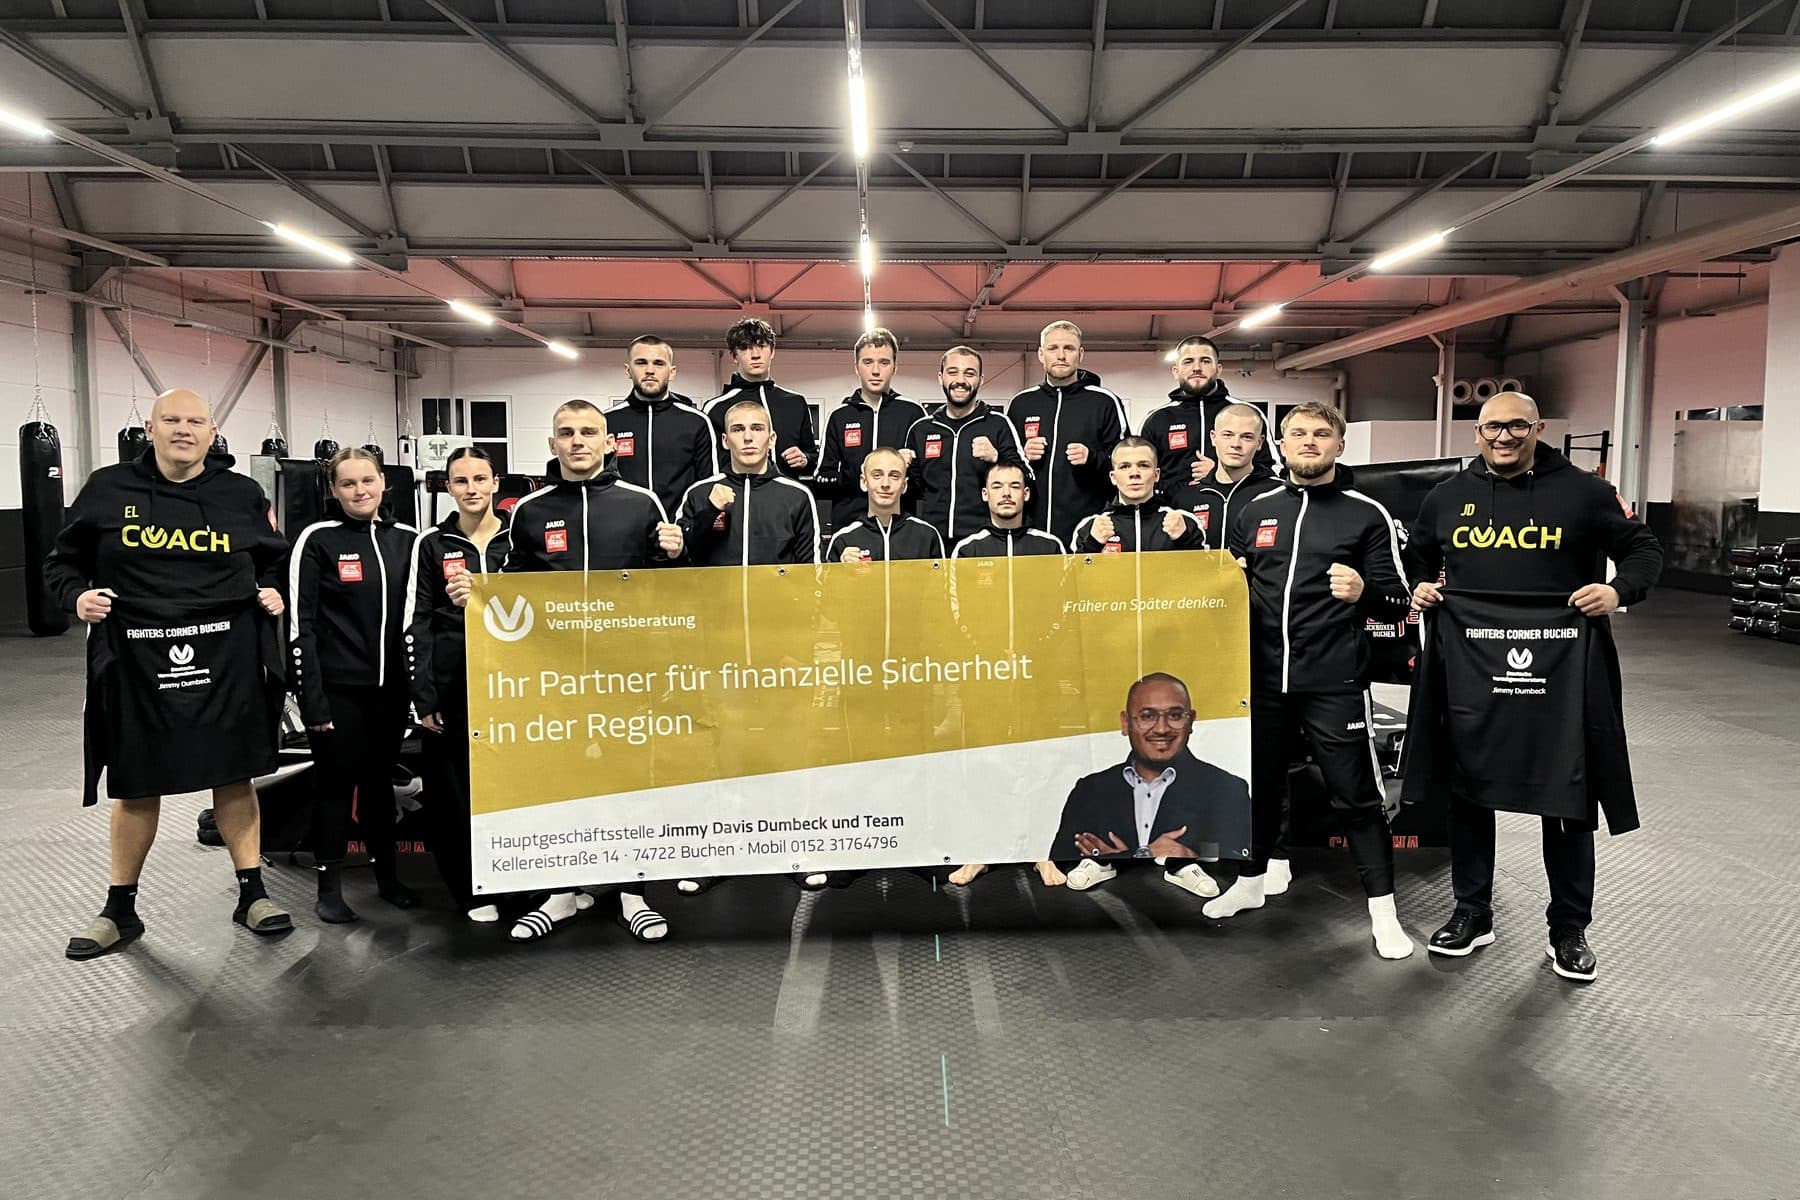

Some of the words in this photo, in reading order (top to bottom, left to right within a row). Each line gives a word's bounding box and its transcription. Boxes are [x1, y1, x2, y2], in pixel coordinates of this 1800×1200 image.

[124, 505, 140, 518] EL
[1193, 504, 1209, 512] JAKO
[1460, 503, 1476, 516] JD
[545, 520, 565, 529] JAKO
[1260, 519, 1278, 527] JAKO
[121, 524, 231, 553] COACH
[1452, 526, 1562, 549] COACH
[443, 551, 463, 559] JAKO
[545, 598, 615, 613] Deutsche
[1064, 599, 1107, 613] Früher
[1110, 601, 1127, 612] an
[1130, 598, 1174, 614] Später
[1177, 596, 1228, 609] denken.
[126, 628, 165, 639] FIGHTERS
[165, 625, 198, 638] CORNER
[199, 620, 231, 634] BUCHEN
[546, 614, 696, 632] Vermögensberatung
[1466, 628, 1505, 639] FIGHTERS
[1506, 629, 1541, 640] CORNER
[1543, 628, 1578, 639] BUCHEN
[487, 672, 530, 699] Ihr
[540, 669, 657, 696] Partner
[665, 664, 711, 691] für
[720, 657, 873, 689] finanzielle
[881, 654, 1033, 685] Sicherheit
[1491, 686, 1514, 695] Jimmy
[1514, 687, 1547, 695] Dumbeck
[488, 716, 516, 744] in
[525, 714, 577, 741] der
[587, 709, 693, 745] Region
[1347, 722, 1365, 730] JAKO
[491, 825, 655, 850] Hauptgeschäftsstelle
[658, 823, 708, 839] Jimmy
[713, 819, 753, 835] Davis
[757, 816, 828, 833] Dumbeck
[831, 815, 860, 829] und
[864, 815, 904, 828] Team
[491, 850, 598, 872] Kellereistraße
[603, 850, 620, 863] 14
[633, 846, 676, 862] 74722
[681, 843, 735, 859] Buchen
[748, 840, 786, 856] Mobil
[791, 839, 825, 853] 0152
[830, 836, 898, 851] 31764796
